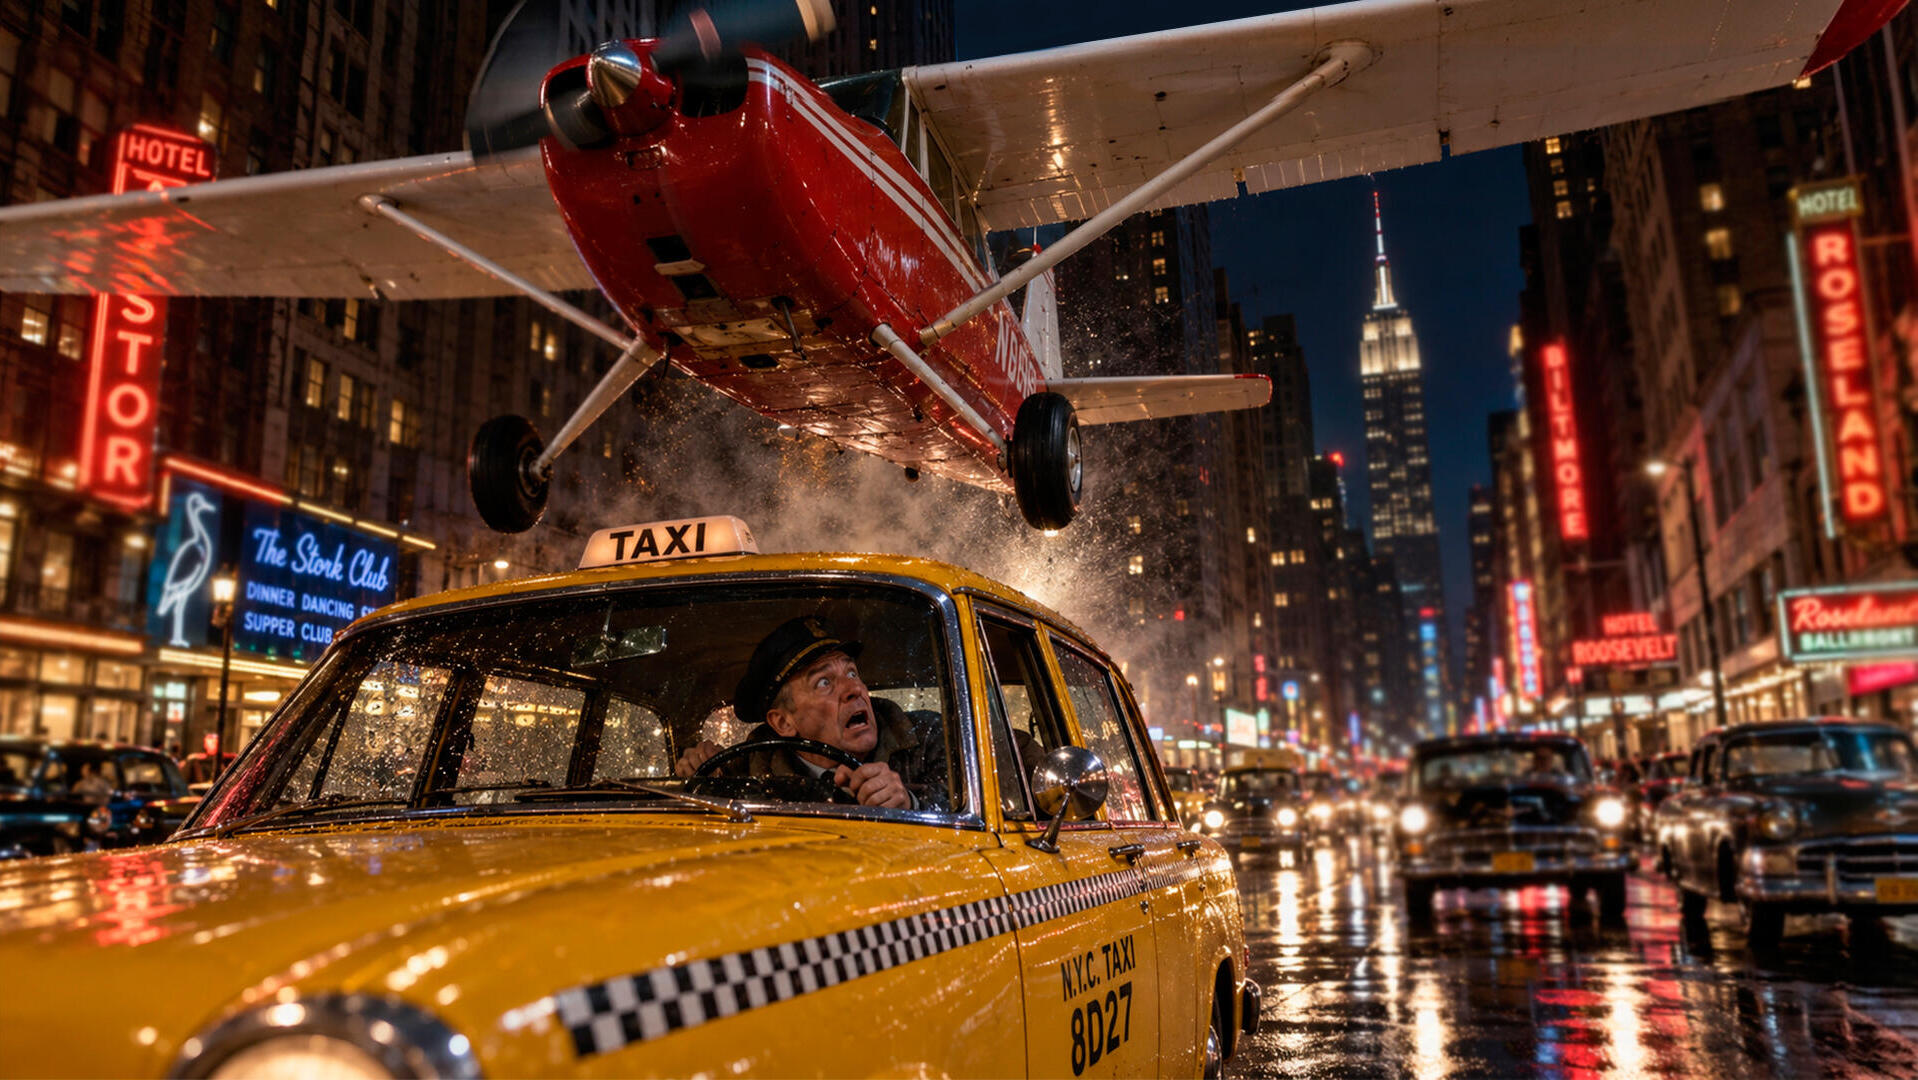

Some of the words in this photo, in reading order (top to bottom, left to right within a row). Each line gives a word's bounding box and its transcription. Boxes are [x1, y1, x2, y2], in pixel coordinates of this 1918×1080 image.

[127, 134, 210, 177] HOTEL
[1797, 186, 1857, 217] HOTEL
[1815, 233, 1884, 517] ROSELAND
[1544, 345, 1587, 538] BILTMORE
[253, 528, 288, 567] The
[291, 532, 345, 581] Stork
[349, 548, 390, 592] Club
[609, 522, 707, 561] TAXI
[246, 581, 296, 608] DINNER
[301, 593, 355, 620] DANCING
[243, 611, 296, 638] SUPPER
[301, 622, 334, 644] CLUB
[1603, 613, 1659, 635] HOTEL
[1572, 634, 1678, 664] ROOSEVELT
[1060, 950, 1101, 1002] N.Y.C.
[1101, 934, 1136, 981] TAXI
[1070, 981, 1133, 1077] 8D27
